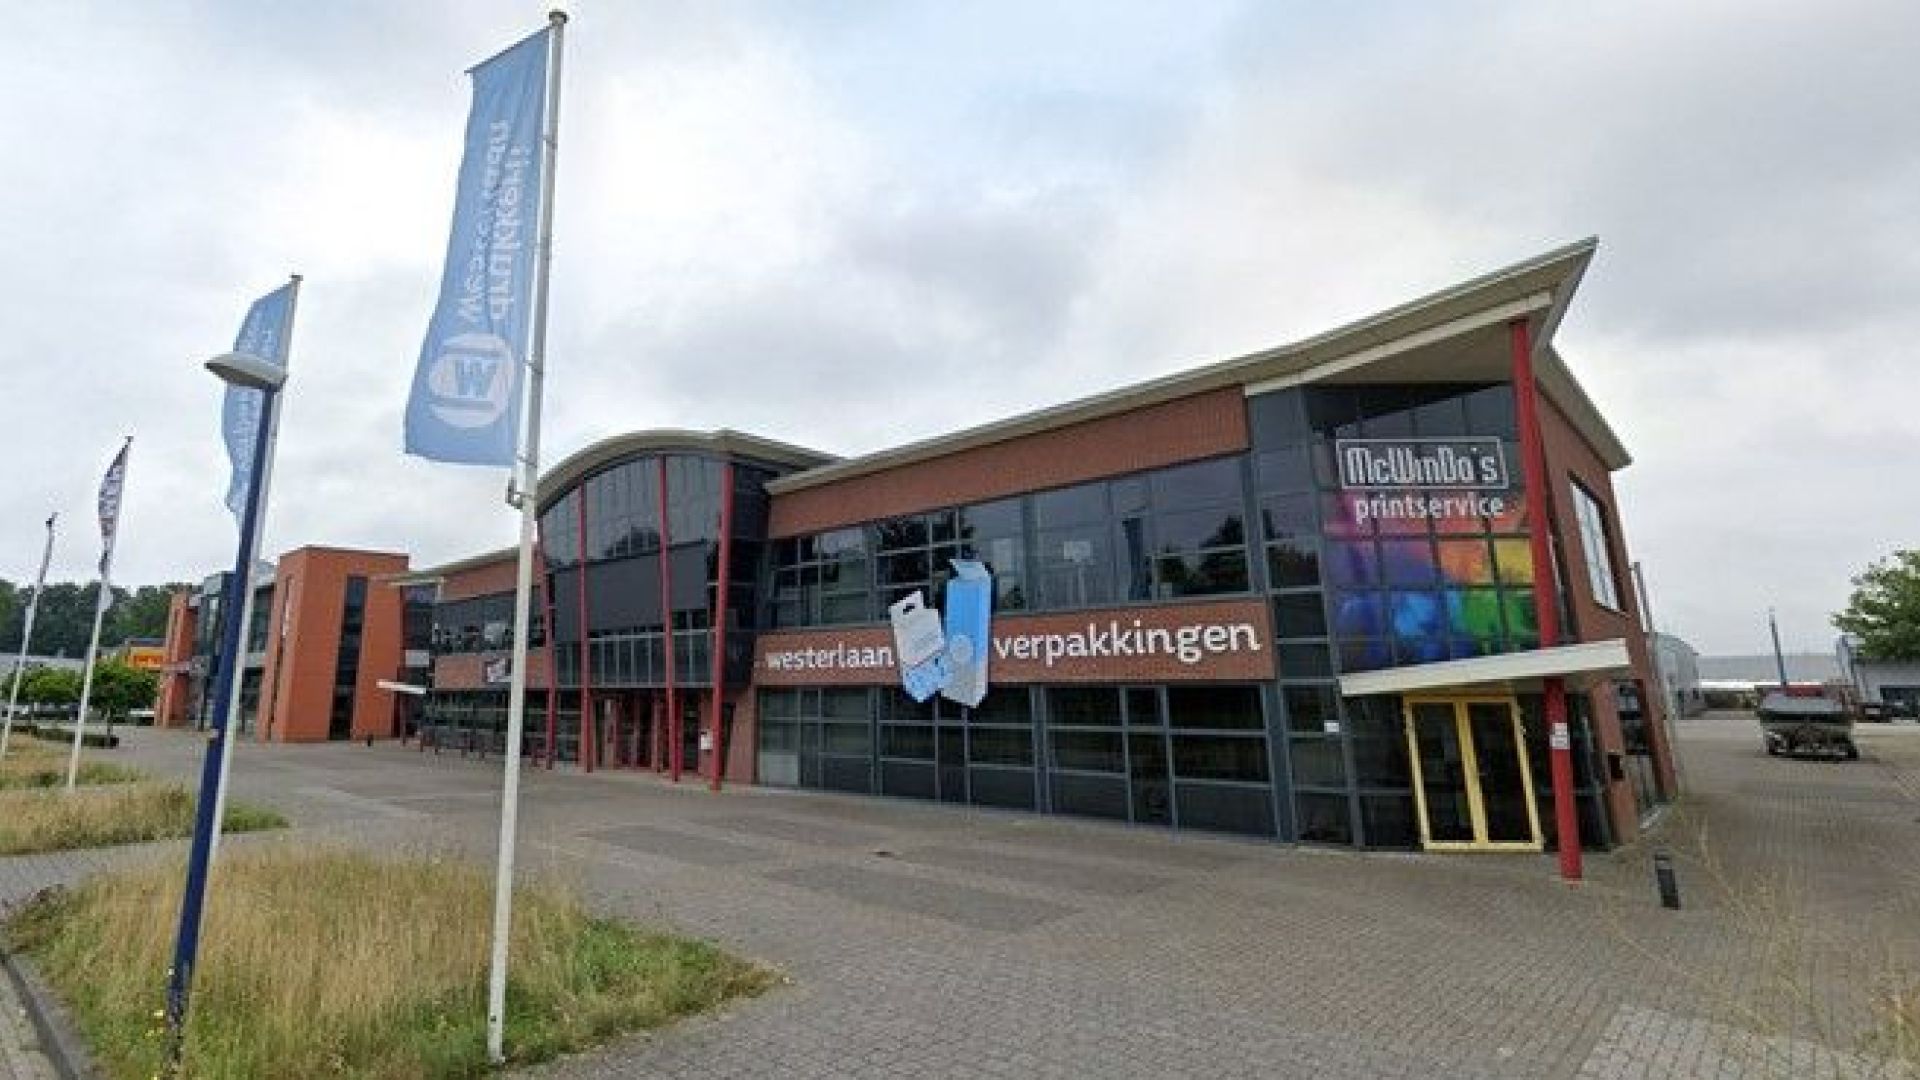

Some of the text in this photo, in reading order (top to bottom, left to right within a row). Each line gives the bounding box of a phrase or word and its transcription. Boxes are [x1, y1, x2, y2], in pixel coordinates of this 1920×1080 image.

[1355, 491, 1504, 525] printservice
[766, 619, 1261, 671] westerlaan verpakkingen
